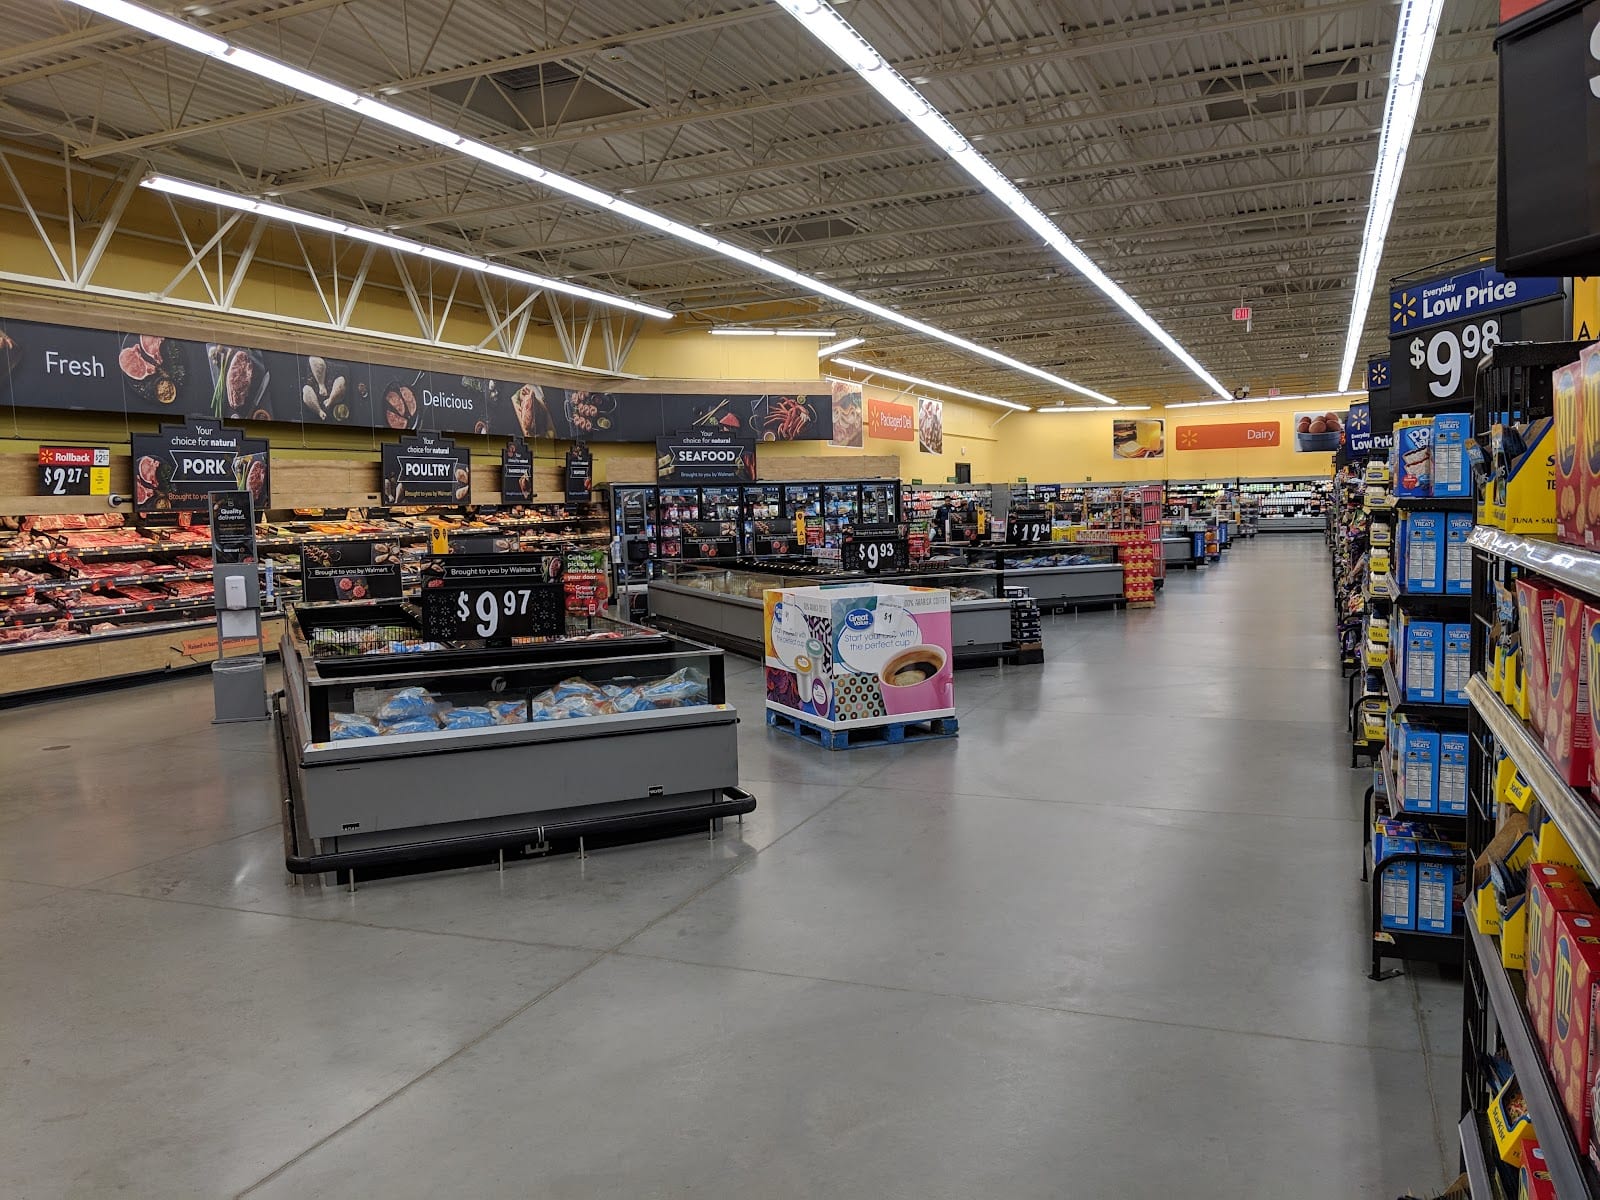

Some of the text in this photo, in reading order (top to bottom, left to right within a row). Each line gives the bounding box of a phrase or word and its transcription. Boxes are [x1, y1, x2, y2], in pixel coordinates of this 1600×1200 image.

[1422, 283, 1456, 299] Everyday
[1422, 280, 1517, 319] Low Price
[45, 350, 105, 378] Fresh
[423, 389, 473, 411] Delicious
[196, 425, 213, 435] Your
[1247, 429, 1275, 442] Dairy
[171, 436, 236, 447] choice for natural
[423, 437, 435, 445] Your
[1351, 432, 1370, 440] Everyday
[1352, 439, 1373, 450] Low
[407, 446, 424, 454] choice
[432, 447, 450, 455] natural
[55, 452, 90, 462] Rollback
[679, 451, 735, 462] SEAFOOD
[183, 458, 226, 475] PORK
[405, 463, 451, 476] POULTRY
[315, 569, 338, 577] Brought
[451, 568, 478, 577] Brought
[488, 567, 499, 576] you
[500, 567, 508, 575] by
[510, 565, 537, 573] Walmart
[848, 614, 869, 622] Great
[844, 634, 862, 643] Start
[899, 629, 915, 637] with
[850, 639, 911, 651] the perfect cup
